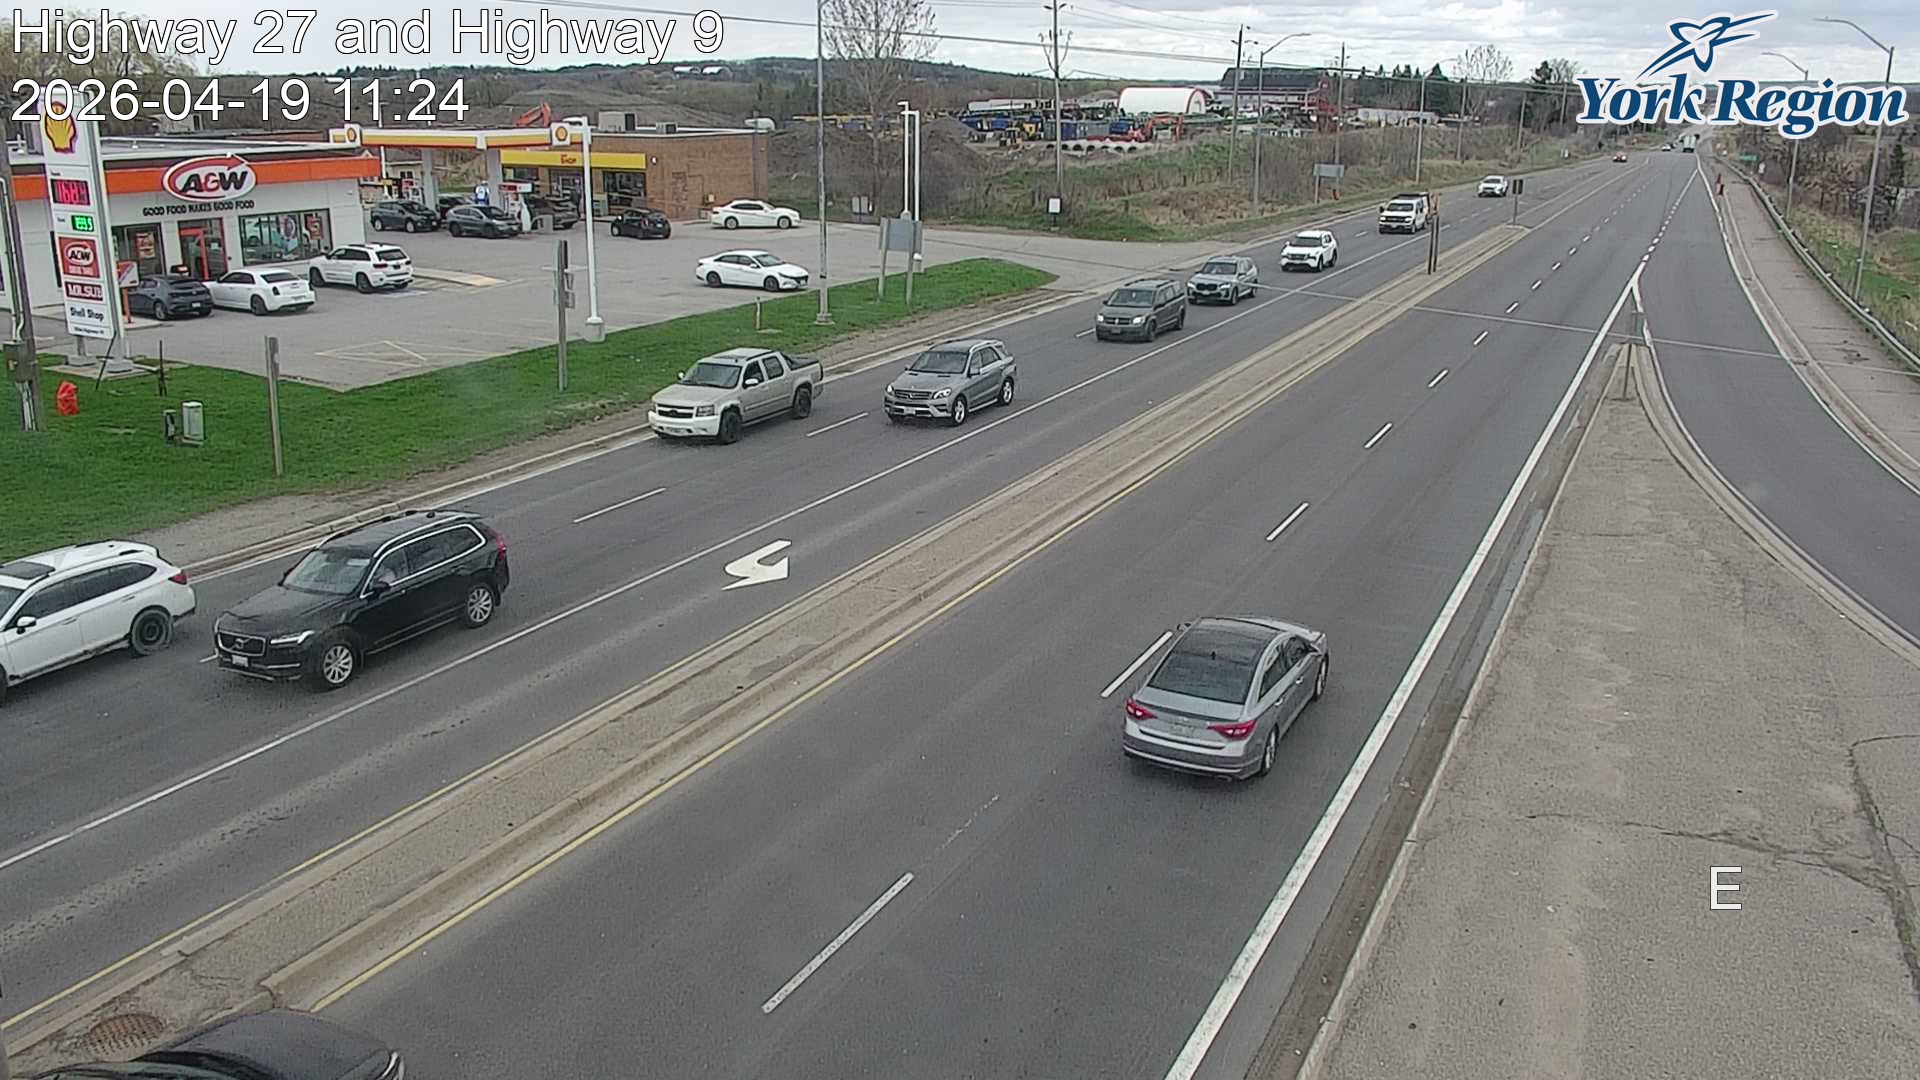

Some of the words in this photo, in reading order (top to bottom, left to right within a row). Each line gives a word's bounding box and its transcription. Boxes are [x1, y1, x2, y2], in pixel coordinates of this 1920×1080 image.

[181, 171, 249, 193] A&W
[142, 206, 165, 217] GOOD
[166, 204, 187, 216] FOOD
[188, 202, 213, 213] MAKES
[213, 200, 235, 212] GOOD
[235, 199, 255, 210] FOOD
[68, 248, 92, 262] A&W
[87, 308, 105, 322] Shop
